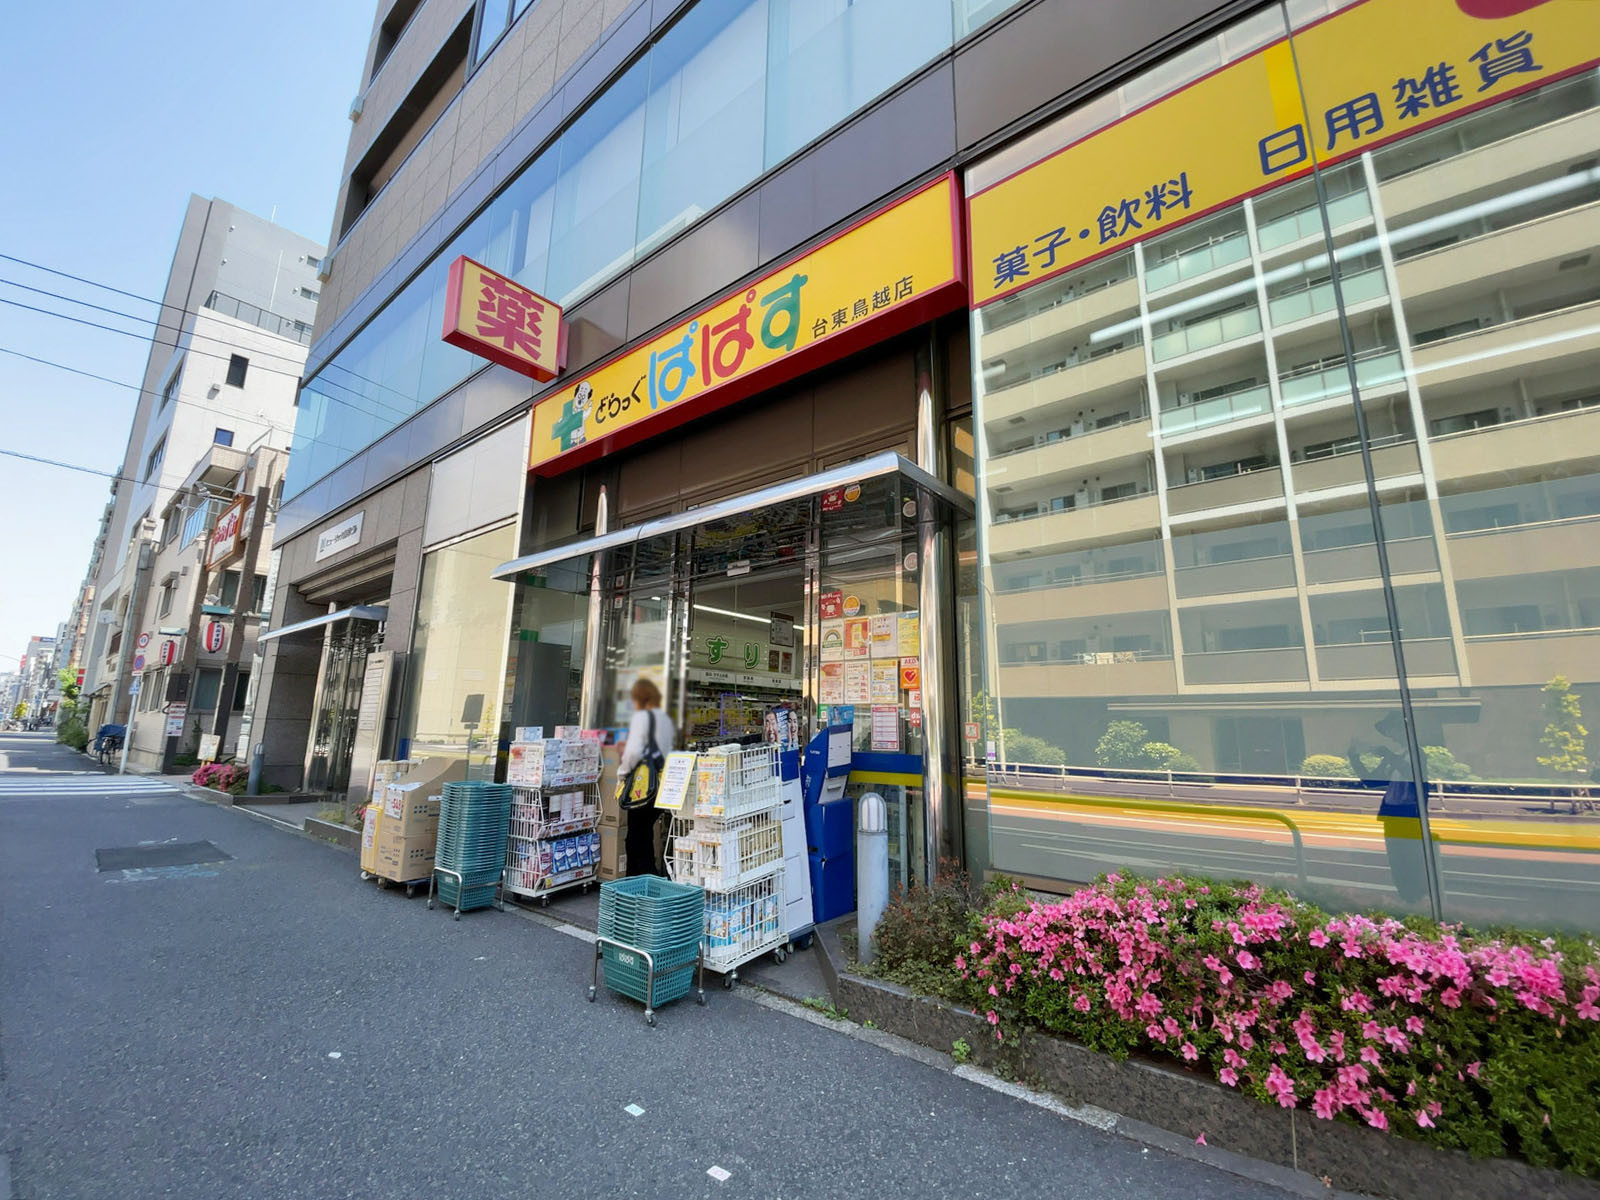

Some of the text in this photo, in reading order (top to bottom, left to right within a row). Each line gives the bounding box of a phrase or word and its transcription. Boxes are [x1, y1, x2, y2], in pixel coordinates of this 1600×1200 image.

[1259, 30, 1543, 175] 日用雑貨
[993, 172, 1193, 289] 菓子・飲料
[475, 272, 545, 361] 薬
[594, 273, 808, 426] どらっぐ ぱぱす
[811, 275, 914, 339] 台東鳥越店
